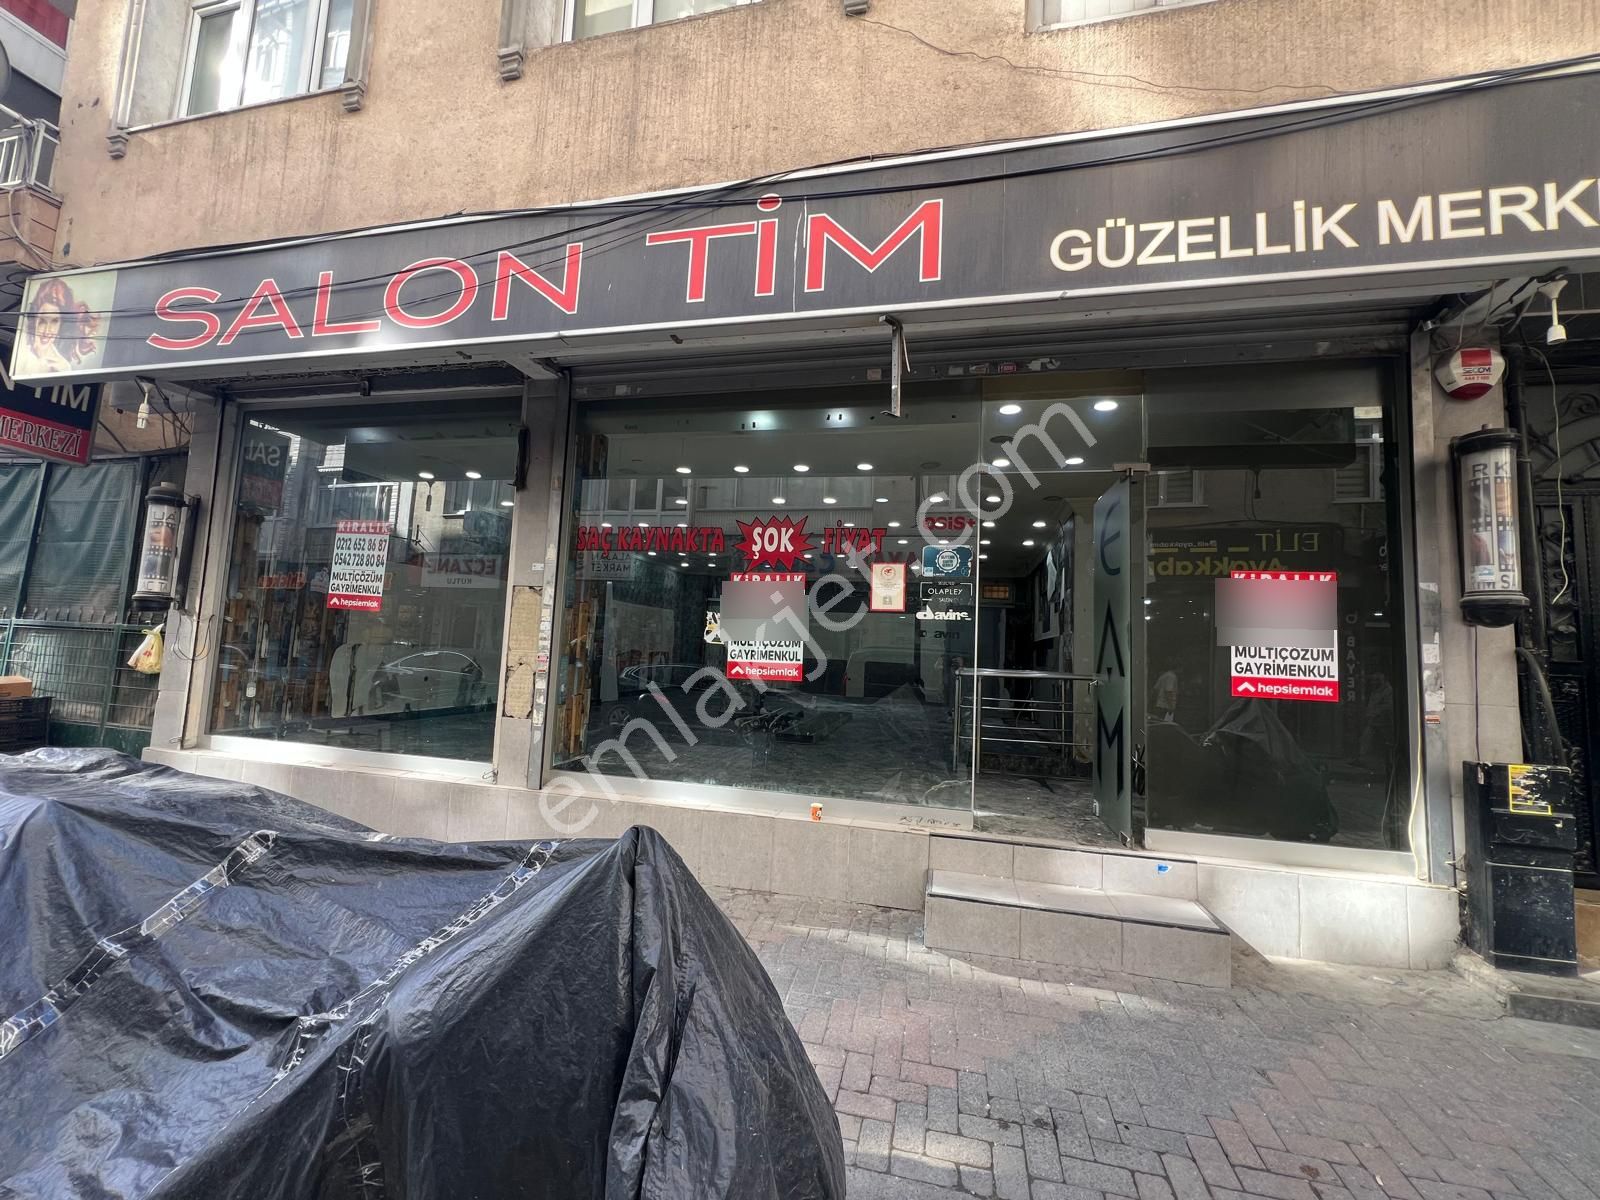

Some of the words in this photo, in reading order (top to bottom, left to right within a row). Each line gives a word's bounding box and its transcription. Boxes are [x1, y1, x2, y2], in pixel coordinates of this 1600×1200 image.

[1049, 199, 1359, 272] GÜZELLİK
[1377, 177, 1600, 247] MERK
[146, 242, 584, 351] SALON
[645, 193, 944, 303] TİM
[336, 537, 351, 551] 0212
[353, 537, 366, 551] 652
[367, 538, 377, 552] 86
[577, 526, 610, 556] SAÇ
[617, 526, 725, 552] KAYNAKTA
[752, 526, 794, 559] ŞOK
[824, 519, 888, 554] FİYAT
[334, 552, 351, 566] 0542
[352, 553, 365, 567] 728
[365, 554, 375, 567] 80
[331, 570, 382, 584] MULTİÇÖZÜM
[330, 582, 381, 594] GAYRİMENKUL
[340, 597, 379, 608] hepsiemlak
[730, 647, 801, 661] GAYRİMENKUL
[745, 666, 799, 678] hepsiemlak
[1235, 660, 1335, 678] GAYRİMENKUL
[1257, 683, 1334, 697] hepsiemlak
